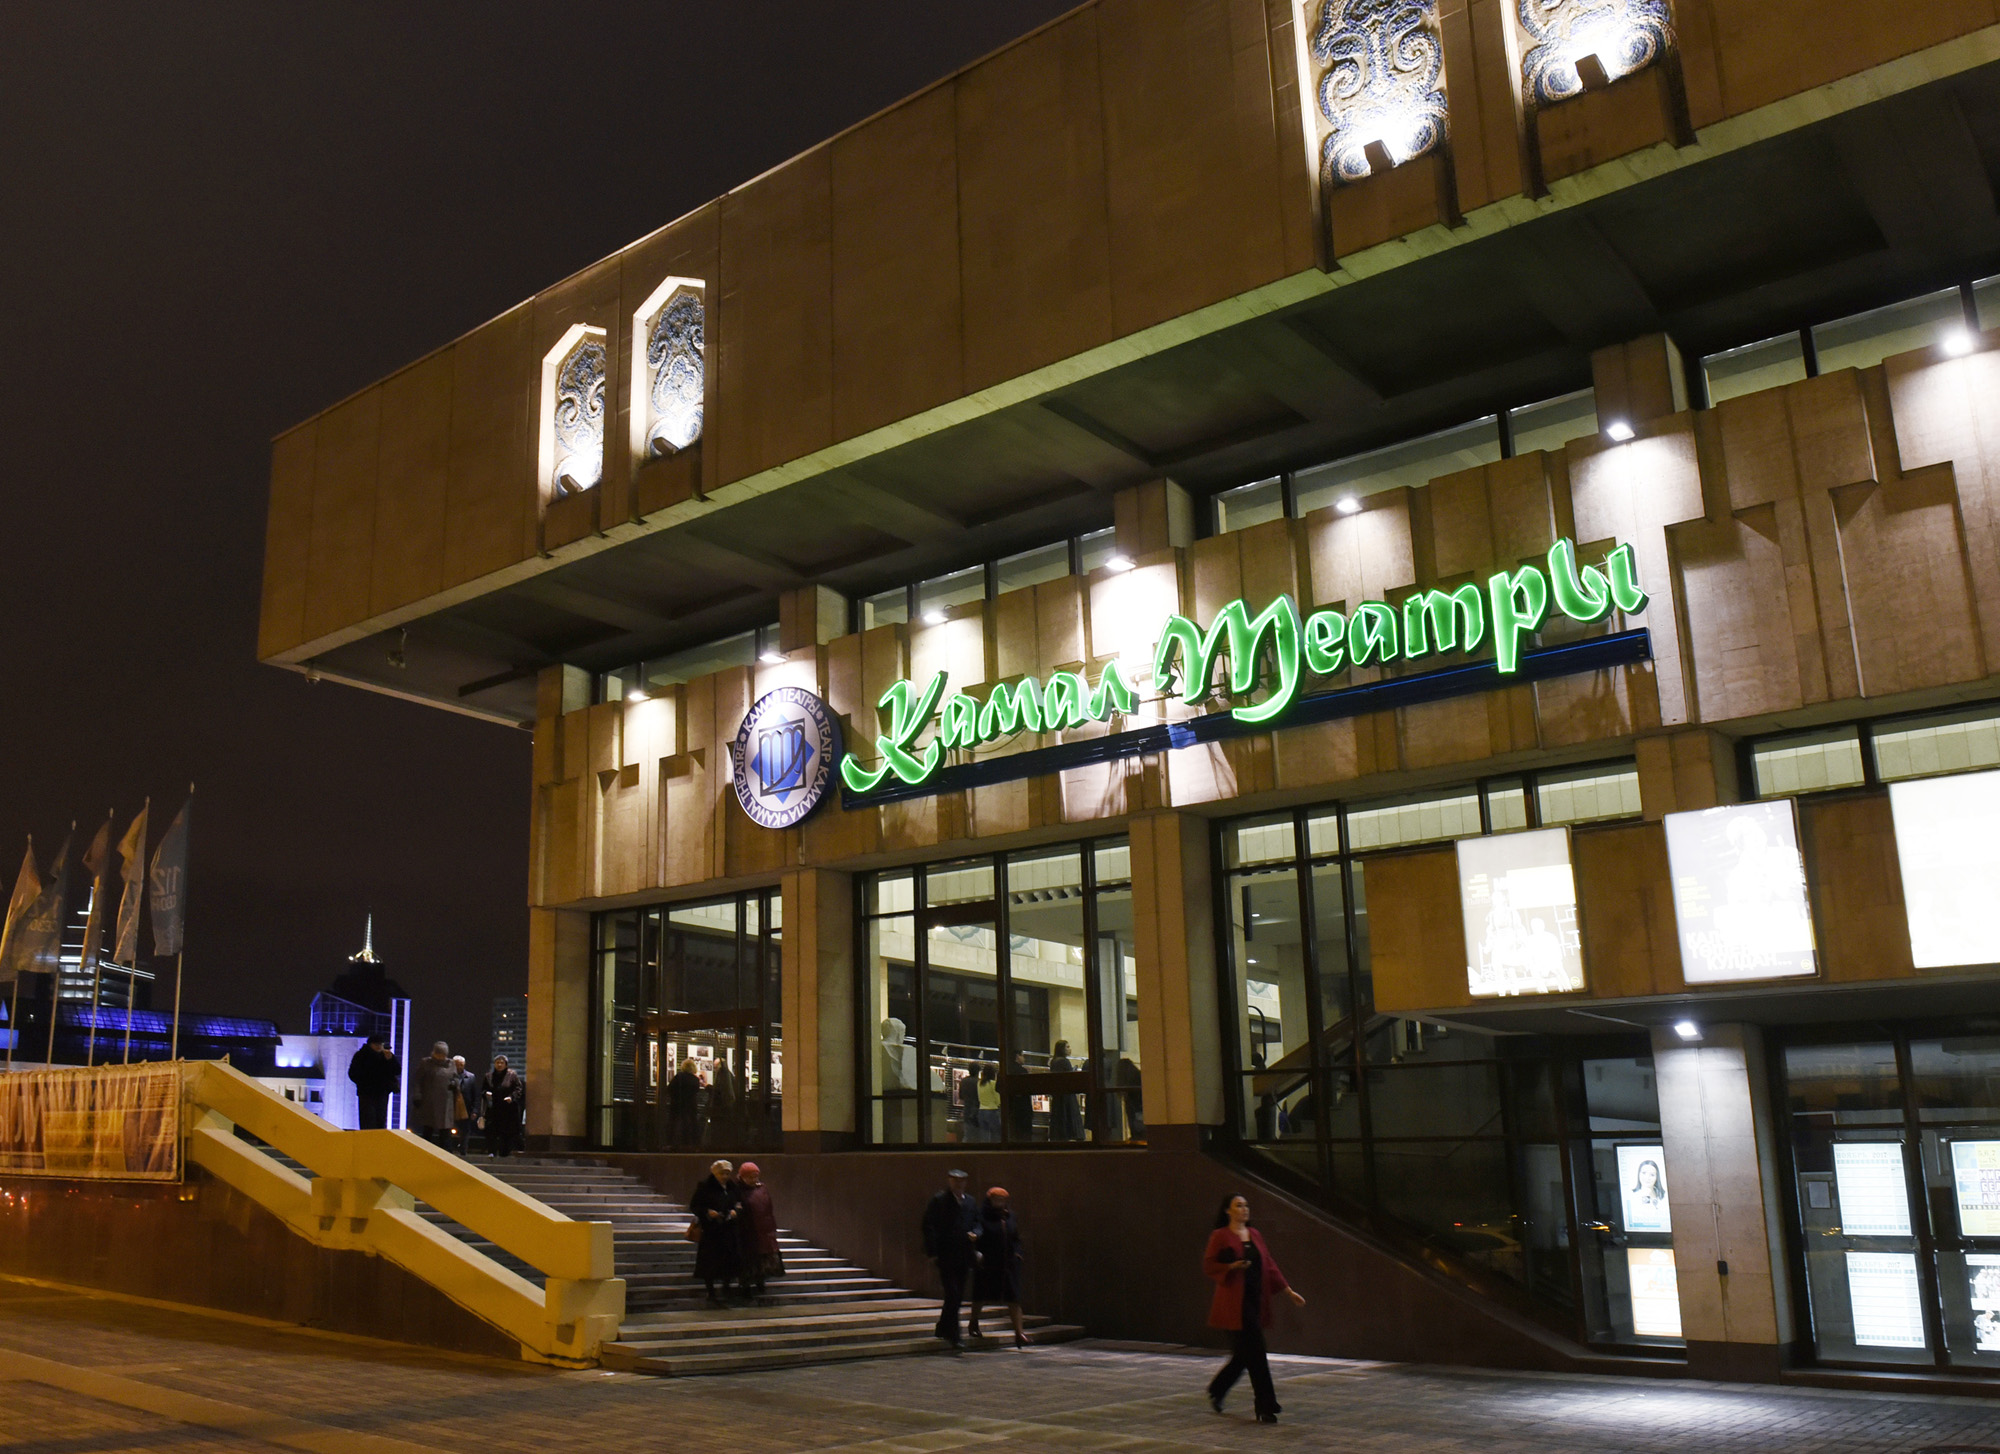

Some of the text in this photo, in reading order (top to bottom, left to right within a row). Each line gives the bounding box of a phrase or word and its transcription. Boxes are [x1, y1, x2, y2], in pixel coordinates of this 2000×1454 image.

[781, 688, 820, 716] ТЕАТРЫ
[839, 541, 1647, 790] Камал Театры
[734, 743, 781, 827] KAMAL THEATRE
[788, 717, 833, 822] ТЕАТР КАМАЛА
